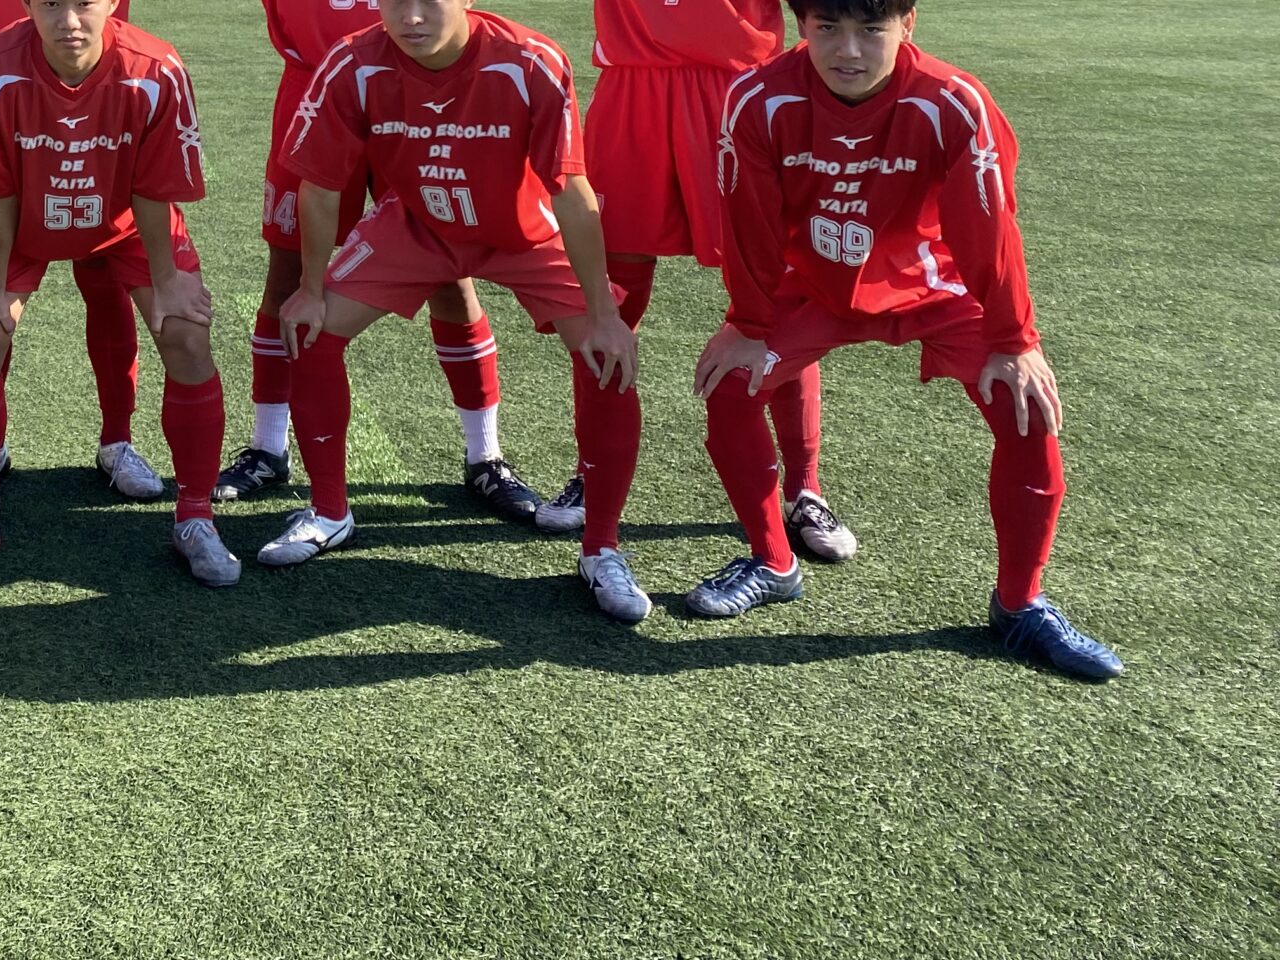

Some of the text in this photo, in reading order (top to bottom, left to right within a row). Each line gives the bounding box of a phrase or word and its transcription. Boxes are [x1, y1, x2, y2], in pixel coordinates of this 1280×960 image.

[435, 123, 511, 139] ESCOLAR
[429, 144, 452, 159] DE
[60, 159, 85, 172] DE
[418, 165, 467, 181] YAITA
[49, 176, 96, 190] YAITA
[833, 181, 862, 195] DE
[44, 193, 103, 231] 53
[419, 185, 479, 226] 81
[818, 199, 869, 217] YAITA
[810, 215, 874, 267] 69
